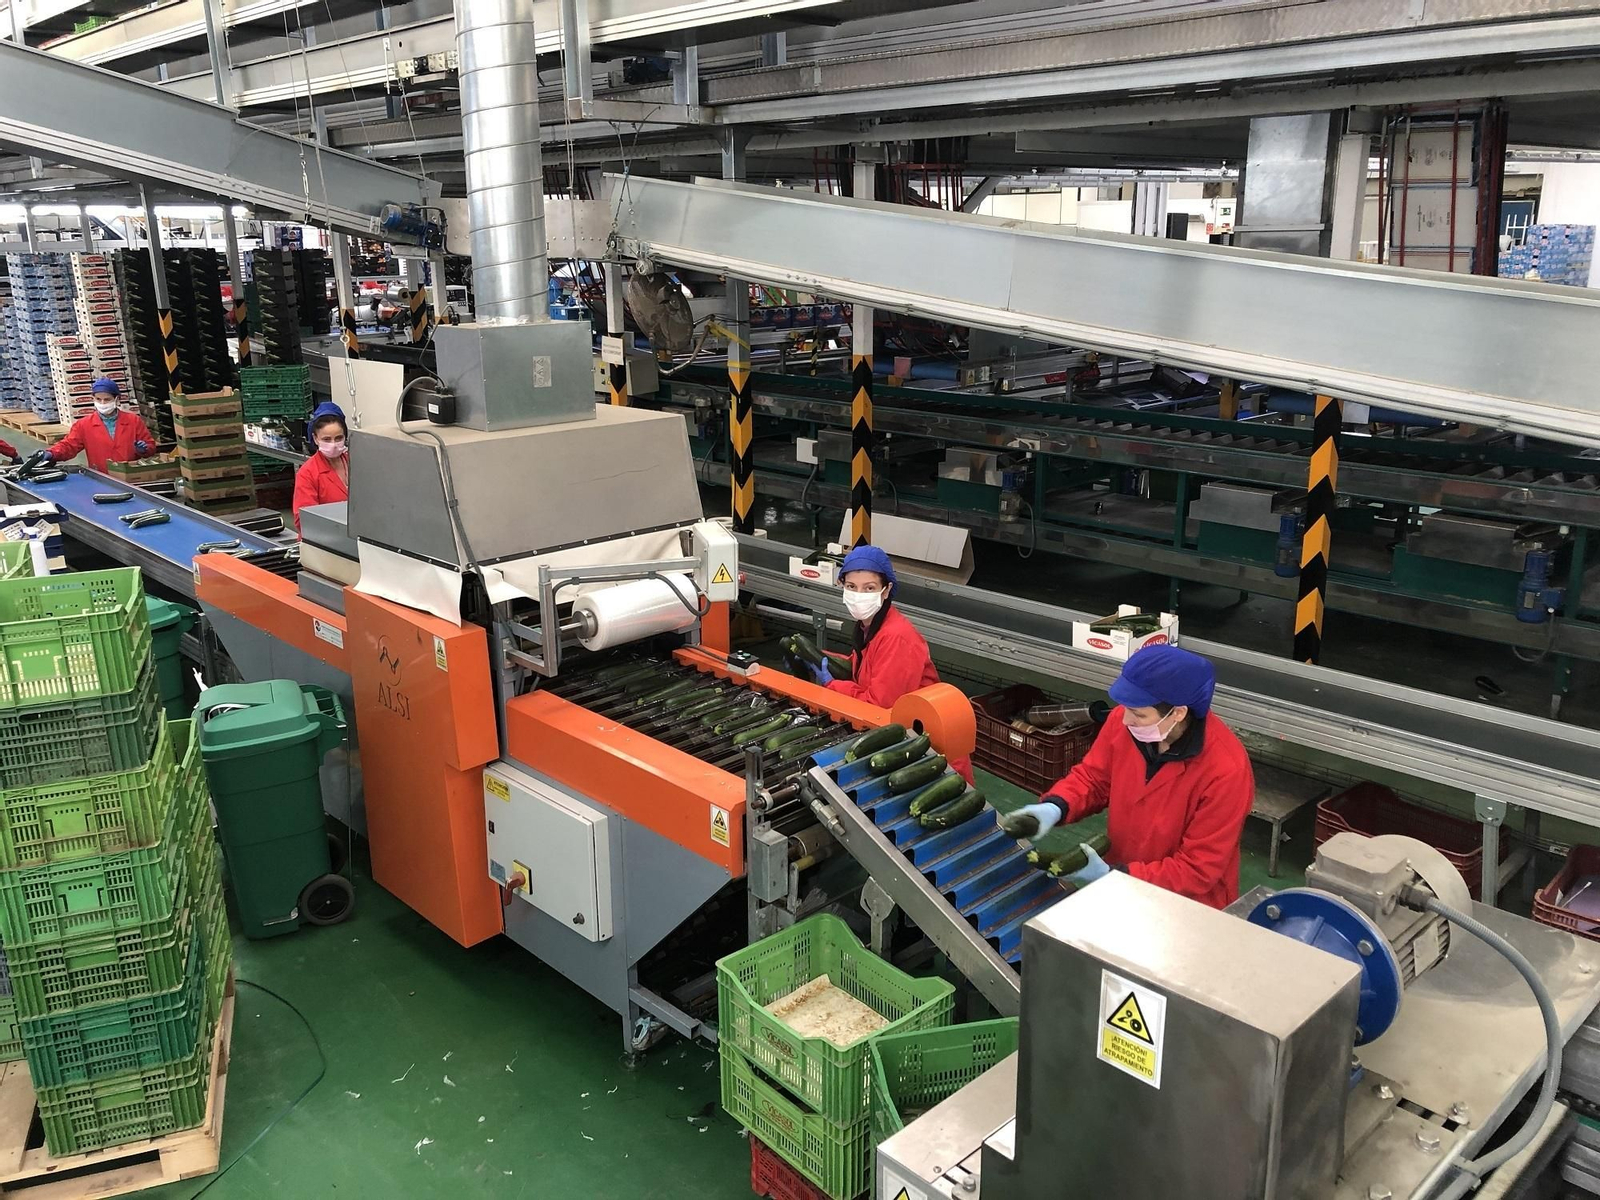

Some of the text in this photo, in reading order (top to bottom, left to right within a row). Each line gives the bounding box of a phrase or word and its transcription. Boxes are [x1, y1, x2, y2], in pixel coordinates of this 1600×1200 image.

[1088, 639, 1112, 649] VICASOL
[378, 682, 411, 721] ALSI
[1111, 1043, 1146, 1065] RIESGO DE
[1112, 1035, 1148, 1056] ¡ATENCIÓN!
[1104, 1048, 1153, 1077] ATRAPAMIENTO
